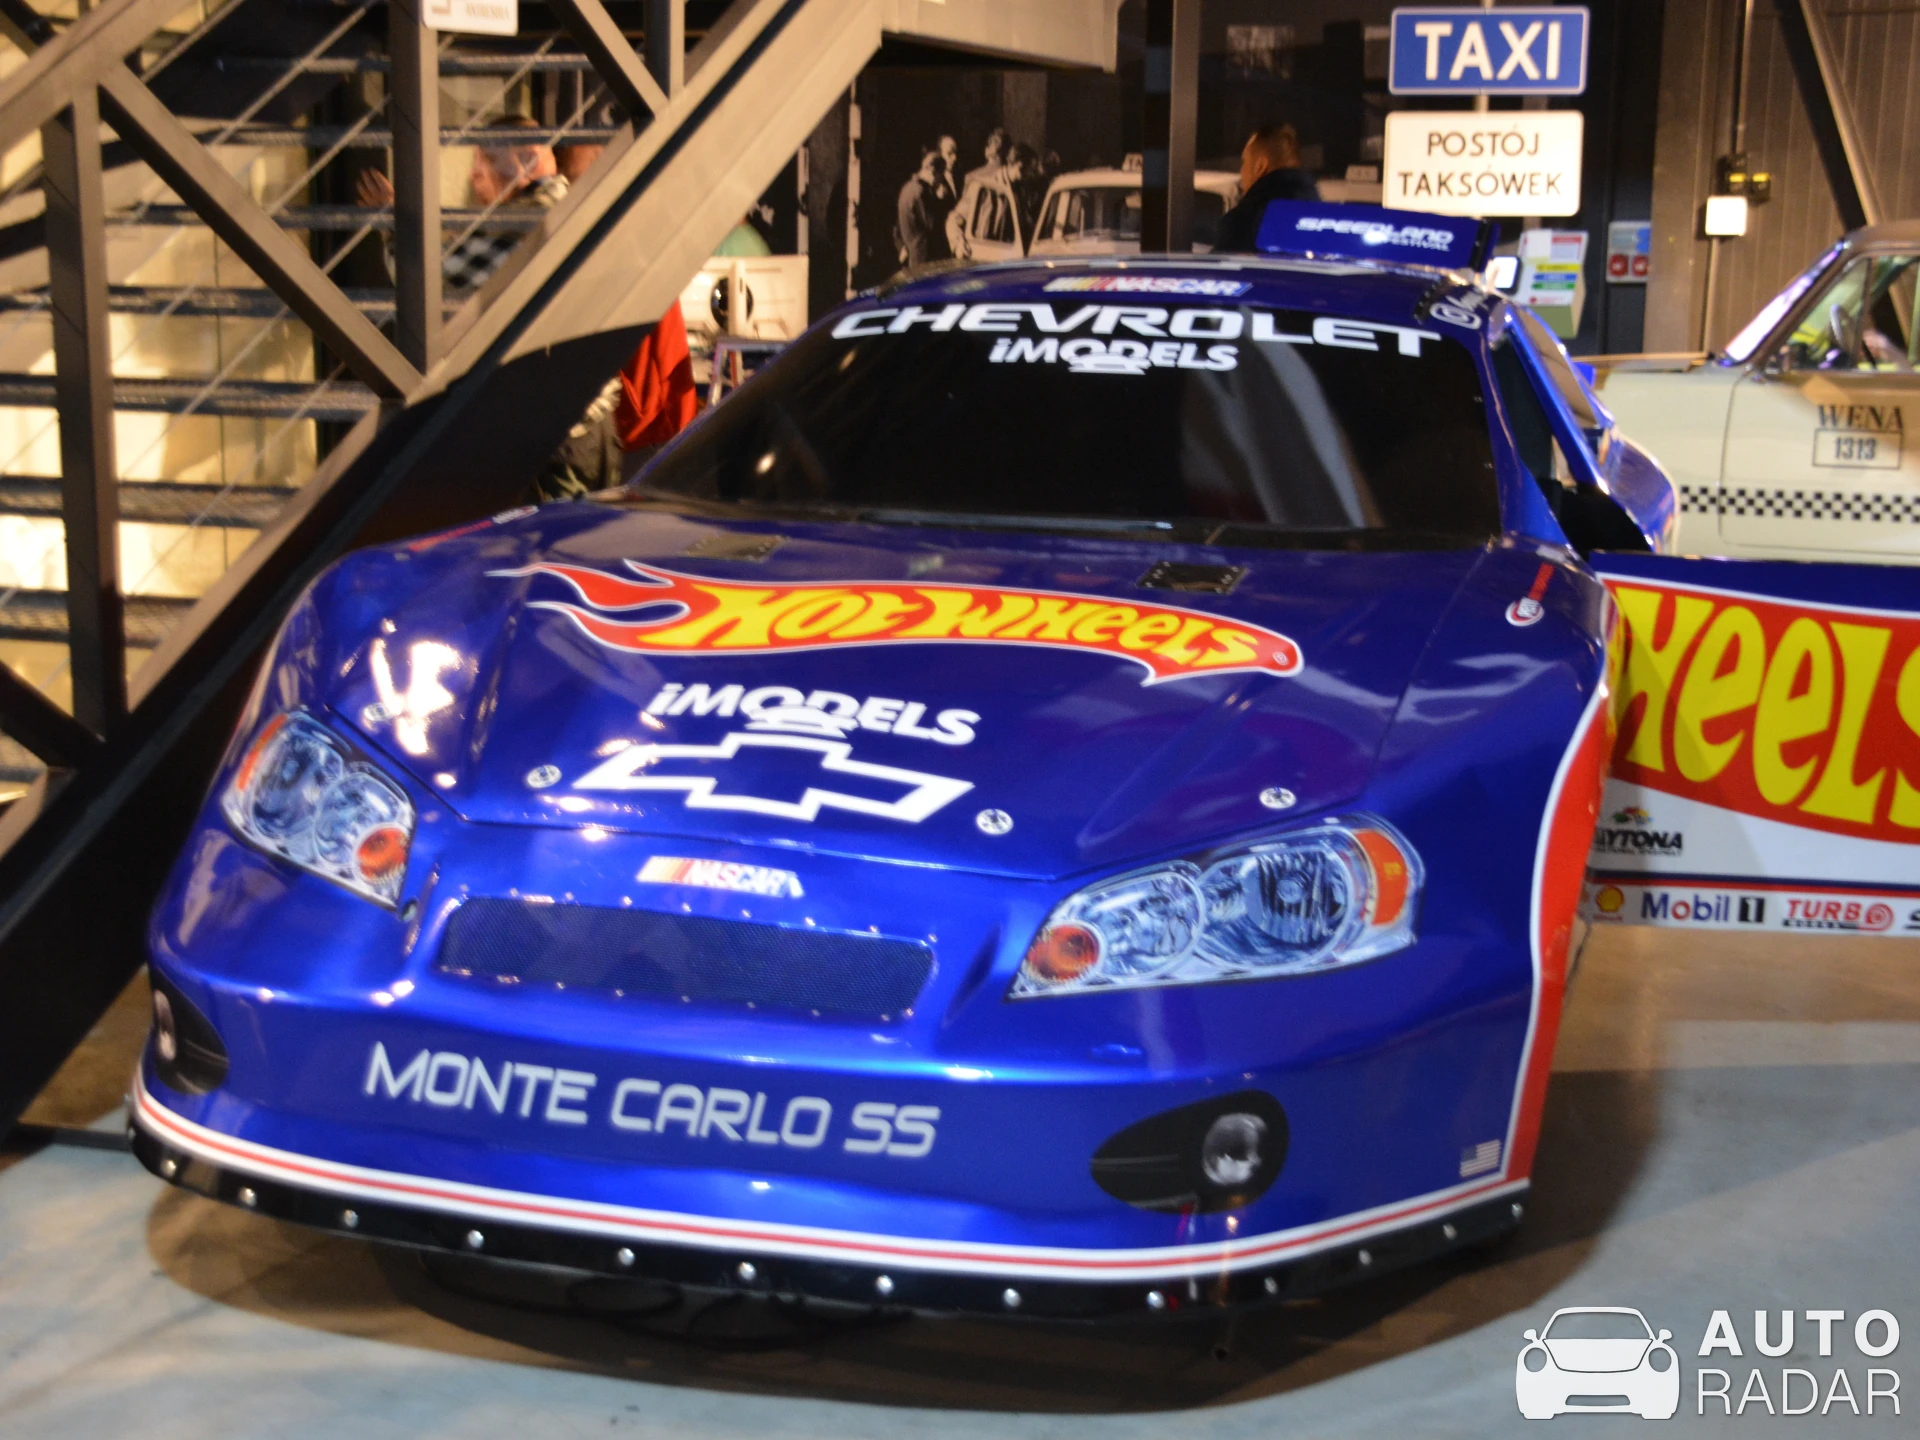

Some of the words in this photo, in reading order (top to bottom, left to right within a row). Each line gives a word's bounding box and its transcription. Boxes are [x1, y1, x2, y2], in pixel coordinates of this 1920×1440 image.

[1414, 21, 1562, 81] TAXI
[1427, 124, 1540, 157] POSTÓJ
[1398, 165, 1562, 197] TAKSÓWEK
[1105, 277, 1244, 297] NASCAR
[831, 303, 1441, 357] CHEVROLET
[1817, 404, 1904, 430] WENA
[1835, 437, 1877, 460] 1313
[637, 583, 922, 648] HOT
[1641, 891, 1731, 922] Mobil
[365, 1041, 597, 1125] MONTE
[611, 1078, 832, 1149] CARLO
[843, 1103, 940, 1158] SS
